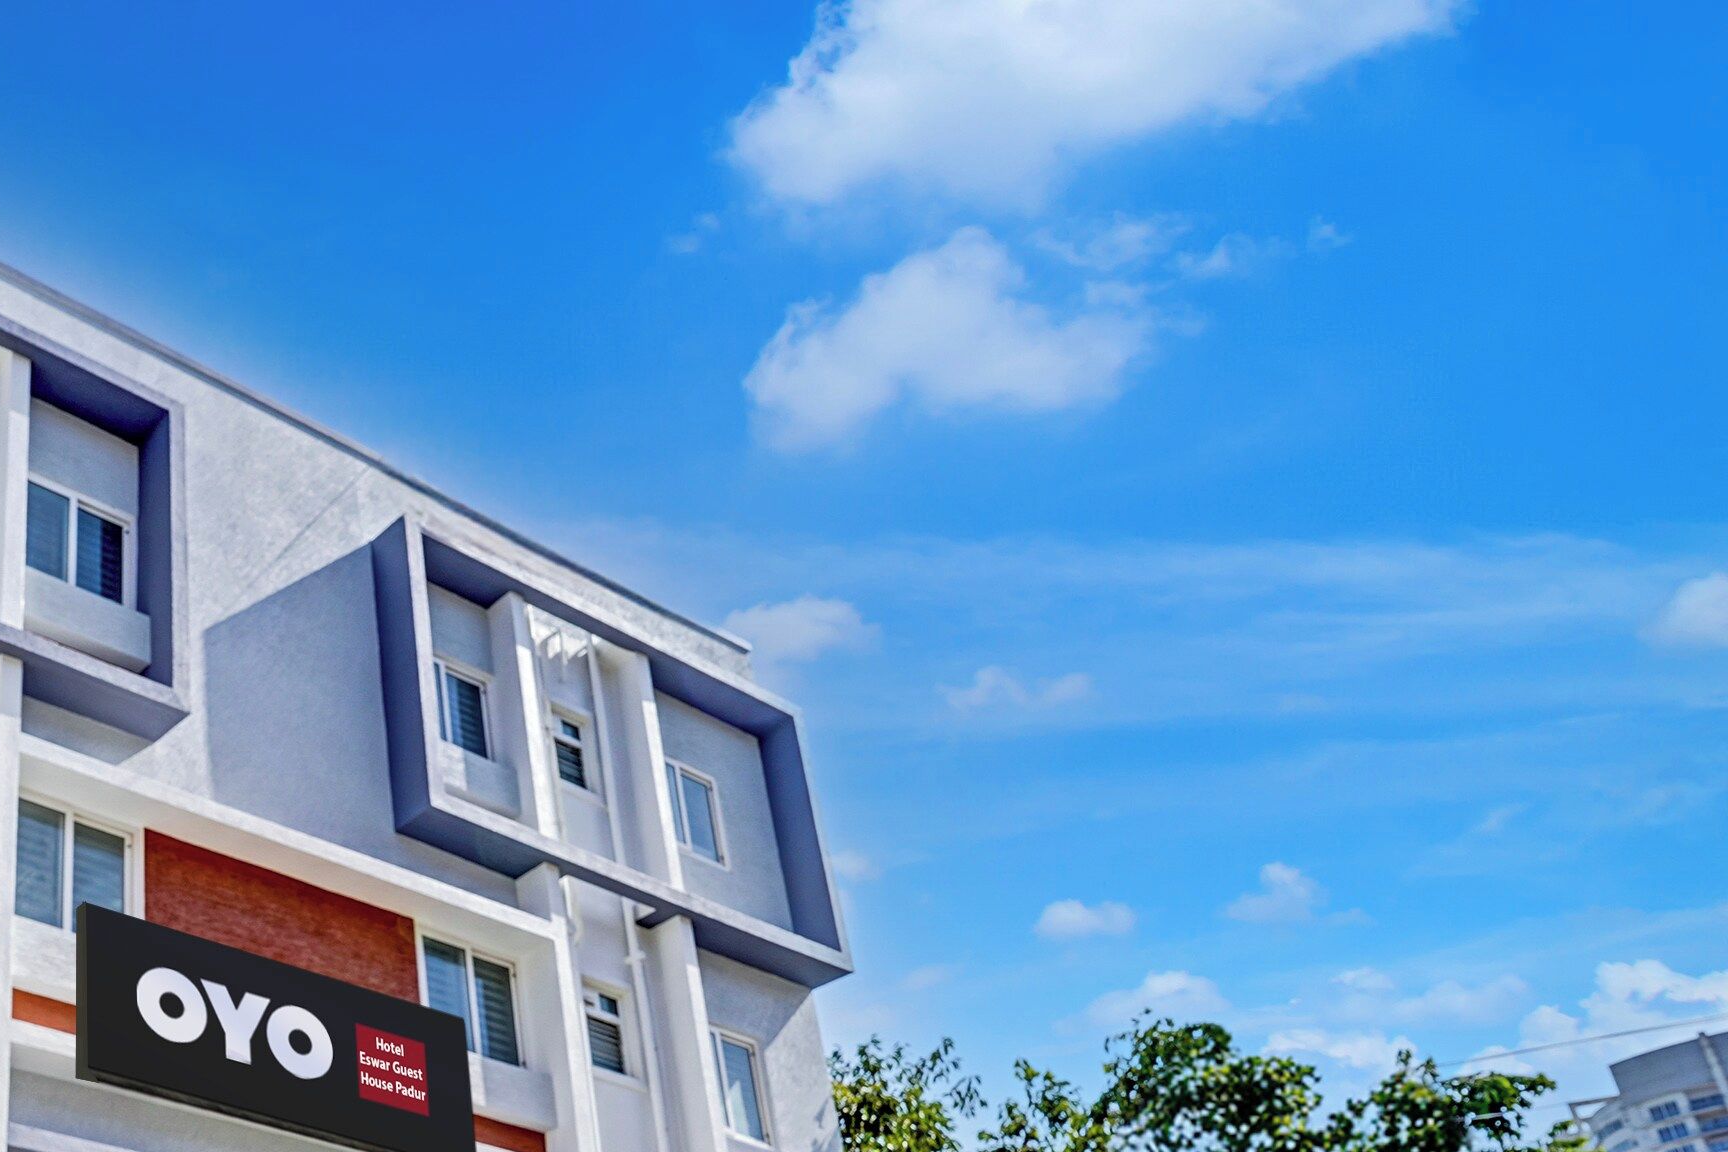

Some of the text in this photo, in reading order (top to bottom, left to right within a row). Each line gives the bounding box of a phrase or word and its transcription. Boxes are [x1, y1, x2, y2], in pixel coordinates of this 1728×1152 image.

[136, 967, 334, 1080] OYO
[375, 1036, 404, 1057] Hotel
[359, 1050, 423, 1081] Eswar Guest
[360, 1070, 426, 1101] House Padur
